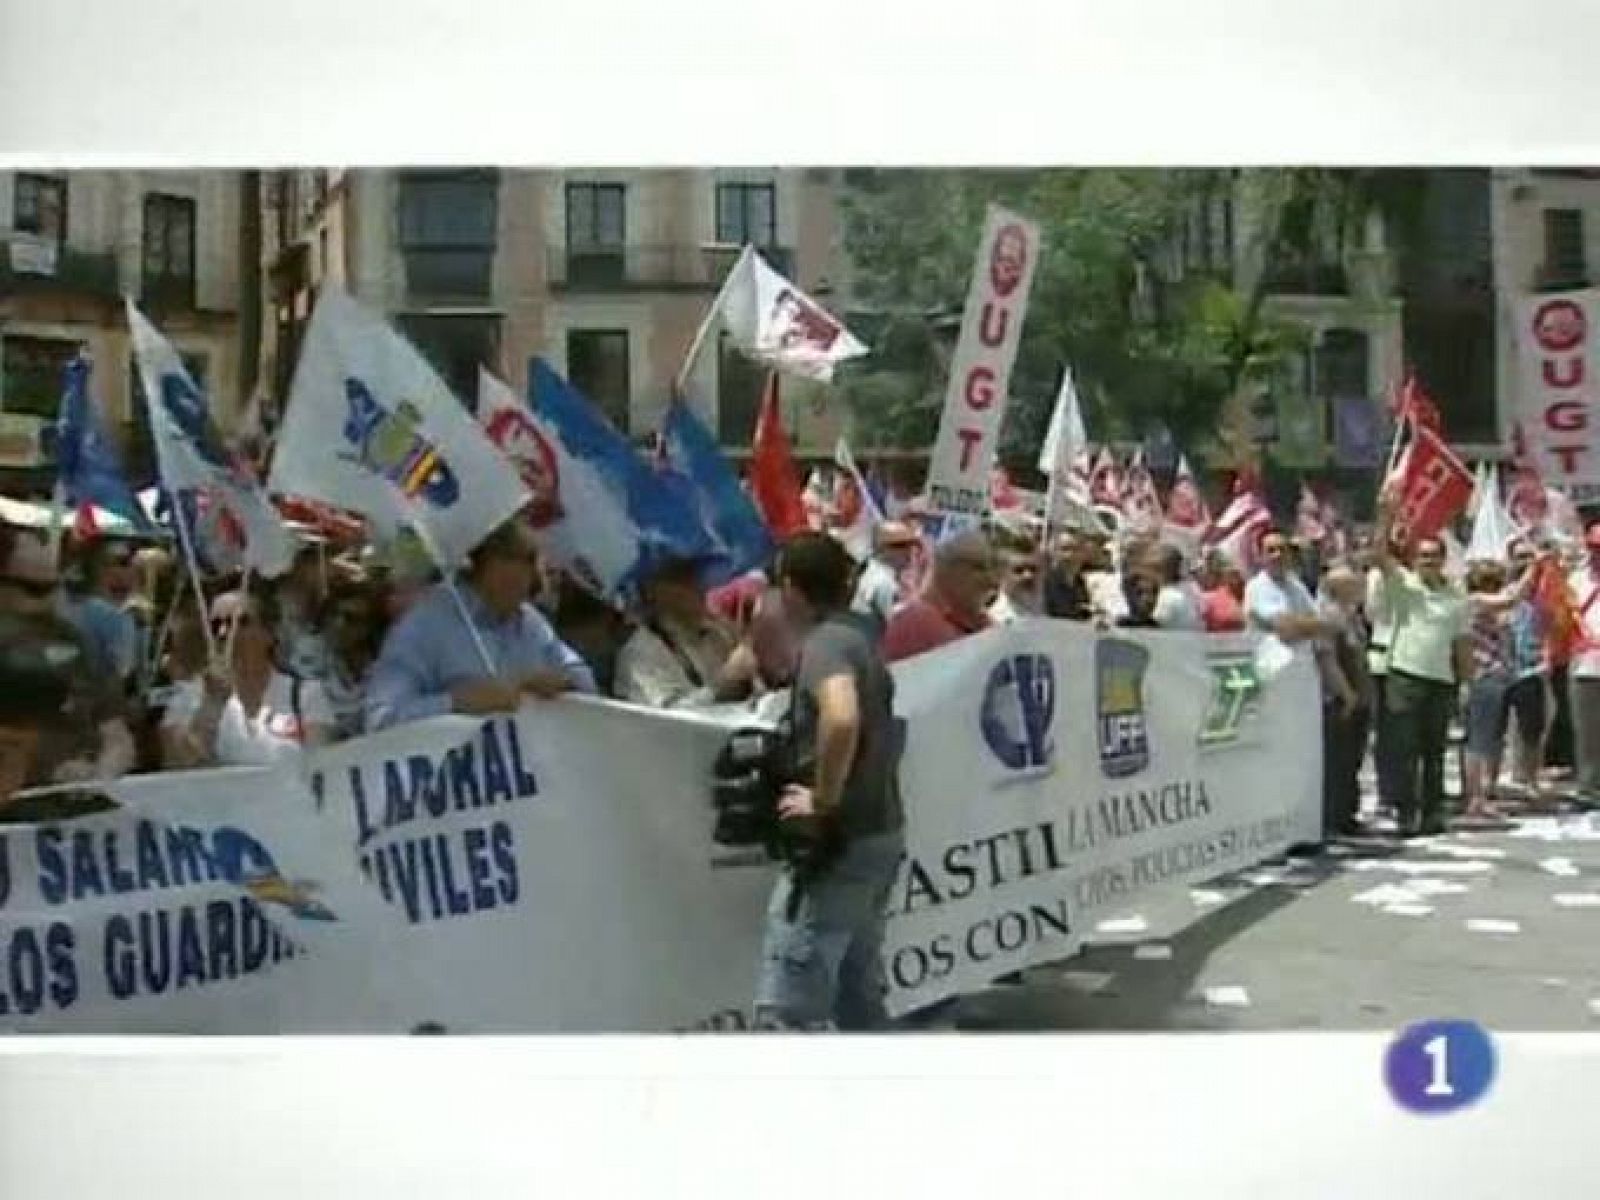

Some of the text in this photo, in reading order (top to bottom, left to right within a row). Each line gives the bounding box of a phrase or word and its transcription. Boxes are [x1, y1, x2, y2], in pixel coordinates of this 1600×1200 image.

[1097, 780, 1211, 838] MANCHA
[966, 898, 1070, 962] CON
[0, 922, 79, 1016] OS
